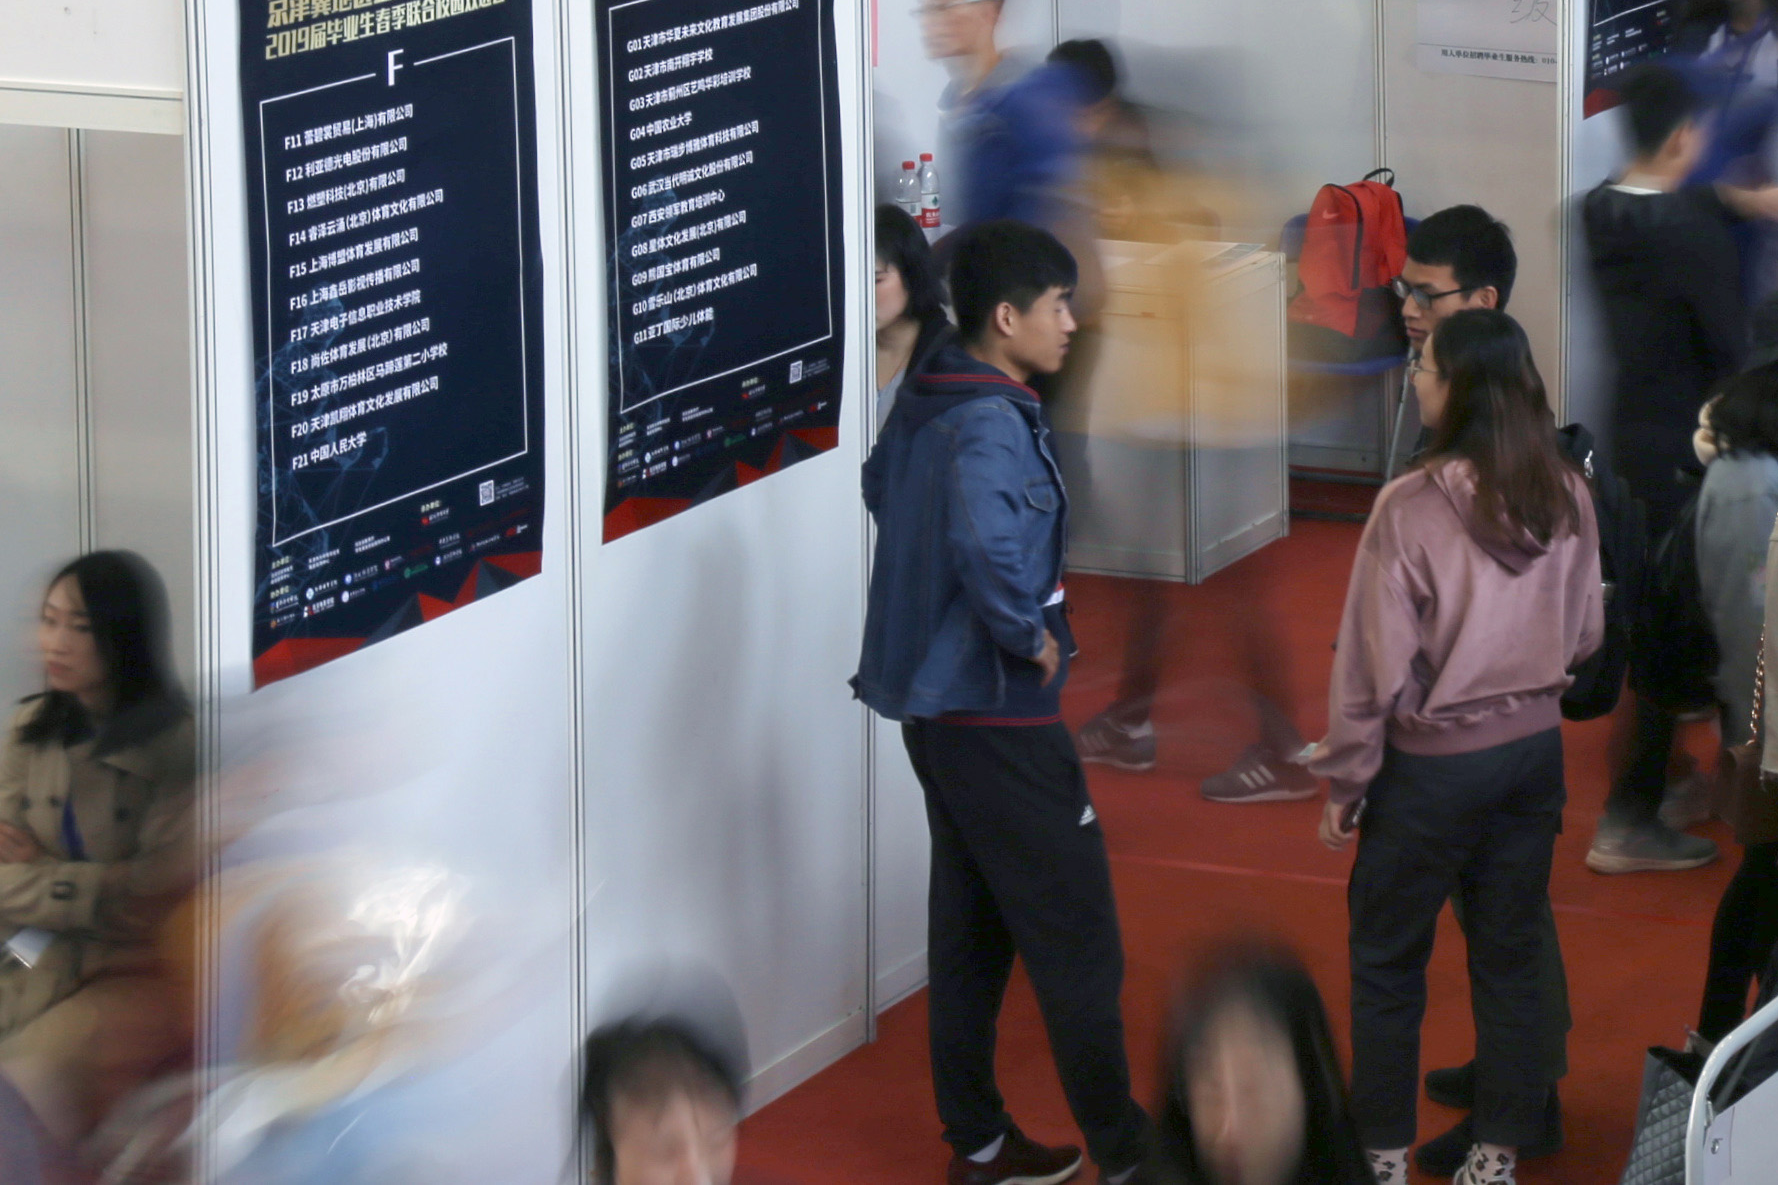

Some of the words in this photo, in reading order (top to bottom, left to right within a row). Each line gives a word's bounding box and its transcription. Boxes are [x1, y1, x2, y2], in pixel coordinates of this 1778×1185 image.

[387, 48, 405, 87] F
[284, 135, 302, 151] F11
[285, 168, 303, 183] F12
[287, 200, 305, 215] F13
[289, 232, 307, 247] F14
[289, 264, 307, 279] F15
[290, 296, 308, 311] F16
[290, 328, 308, 343] F17
[310, 289, 421, 334] 天津电子信息职业技术学院
[291, 360, 308, 375] F18
[291, 392, 308, 407] F19
[291, 424, 308, 439] F20
[292, 455, 308, 470] F21
[310, 430, 368, 465] 中国人民大学
